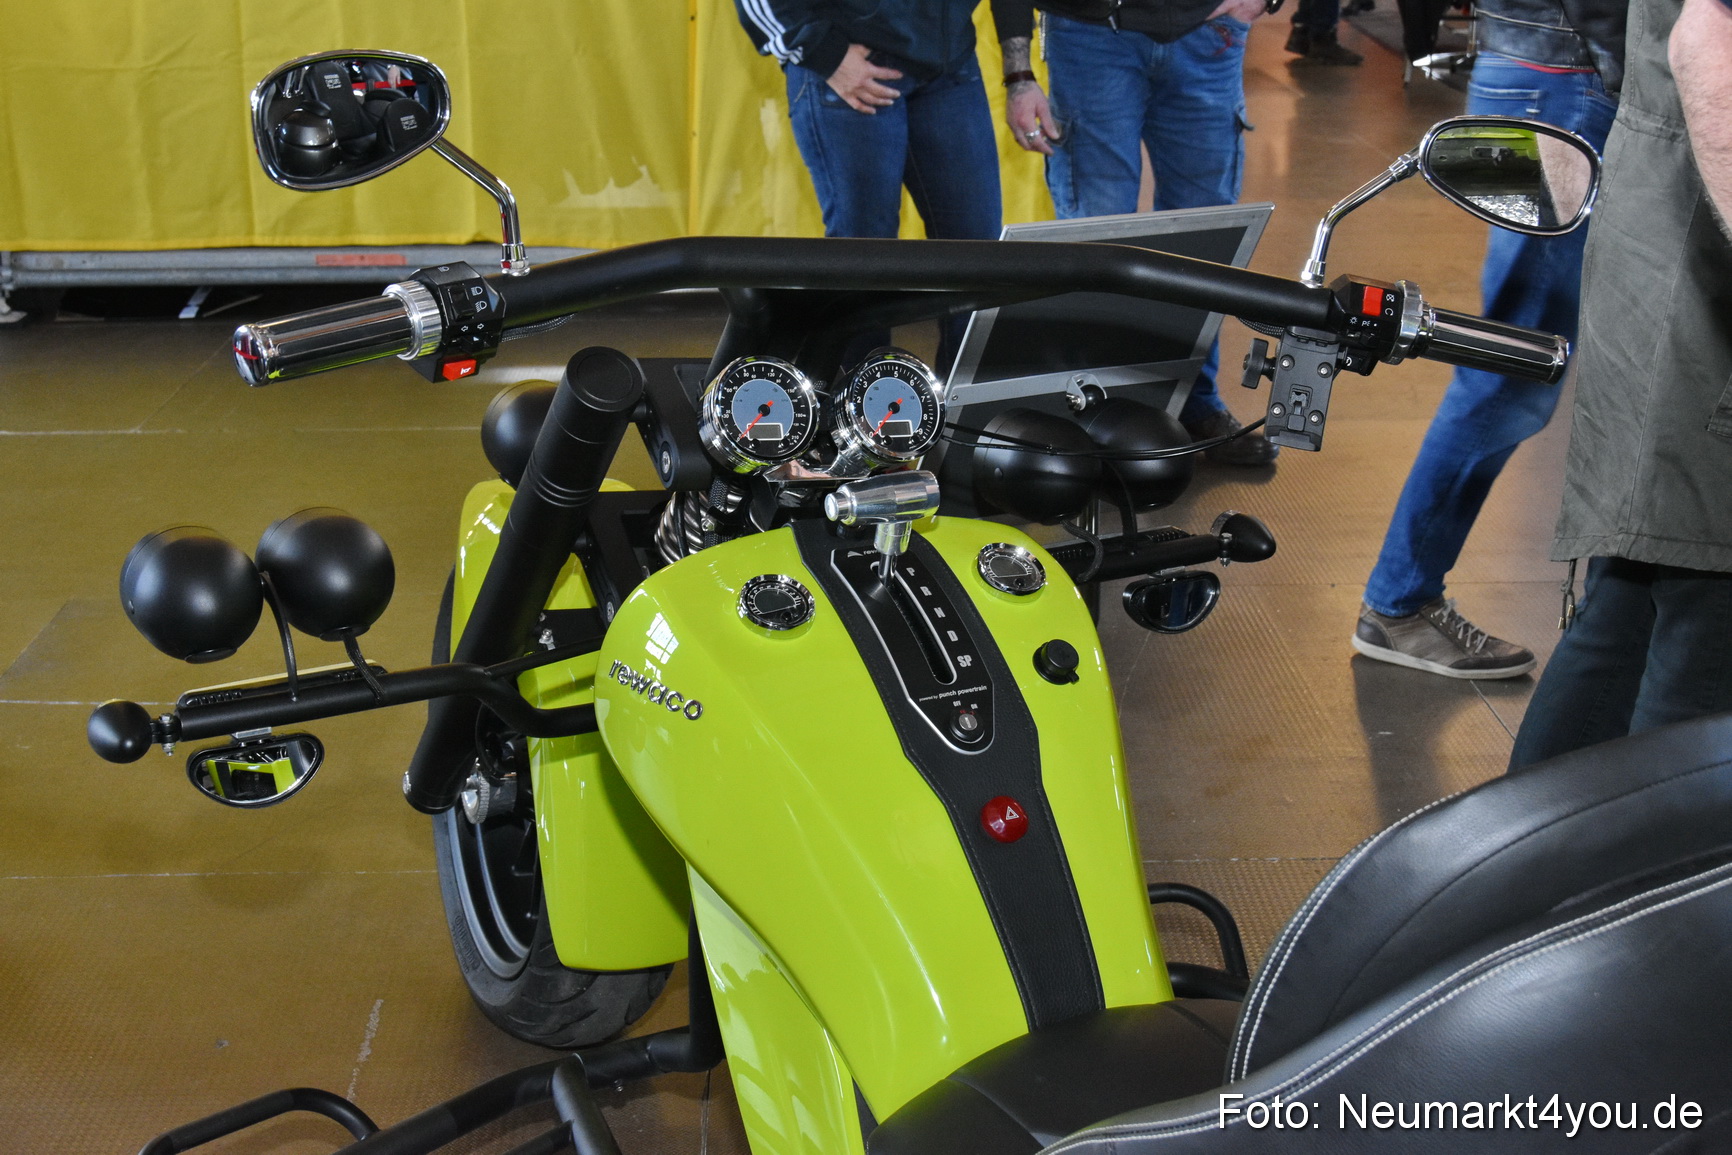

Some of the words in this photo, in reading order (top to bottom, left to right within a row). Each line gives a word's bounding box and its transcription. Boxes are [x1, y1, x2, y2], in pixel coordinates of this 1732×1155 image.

[906, 567, 915, 576] P
[920, 586, 932, 596] R
[934, 607, 946, 618] N
[947, 630, 959, 642] D
[957, 654, 973, 668] SP
[608, 659, 704, 720] rewaco
[939, 690, 956, 699] punch
[958, 685, 987, 695] powertrain
